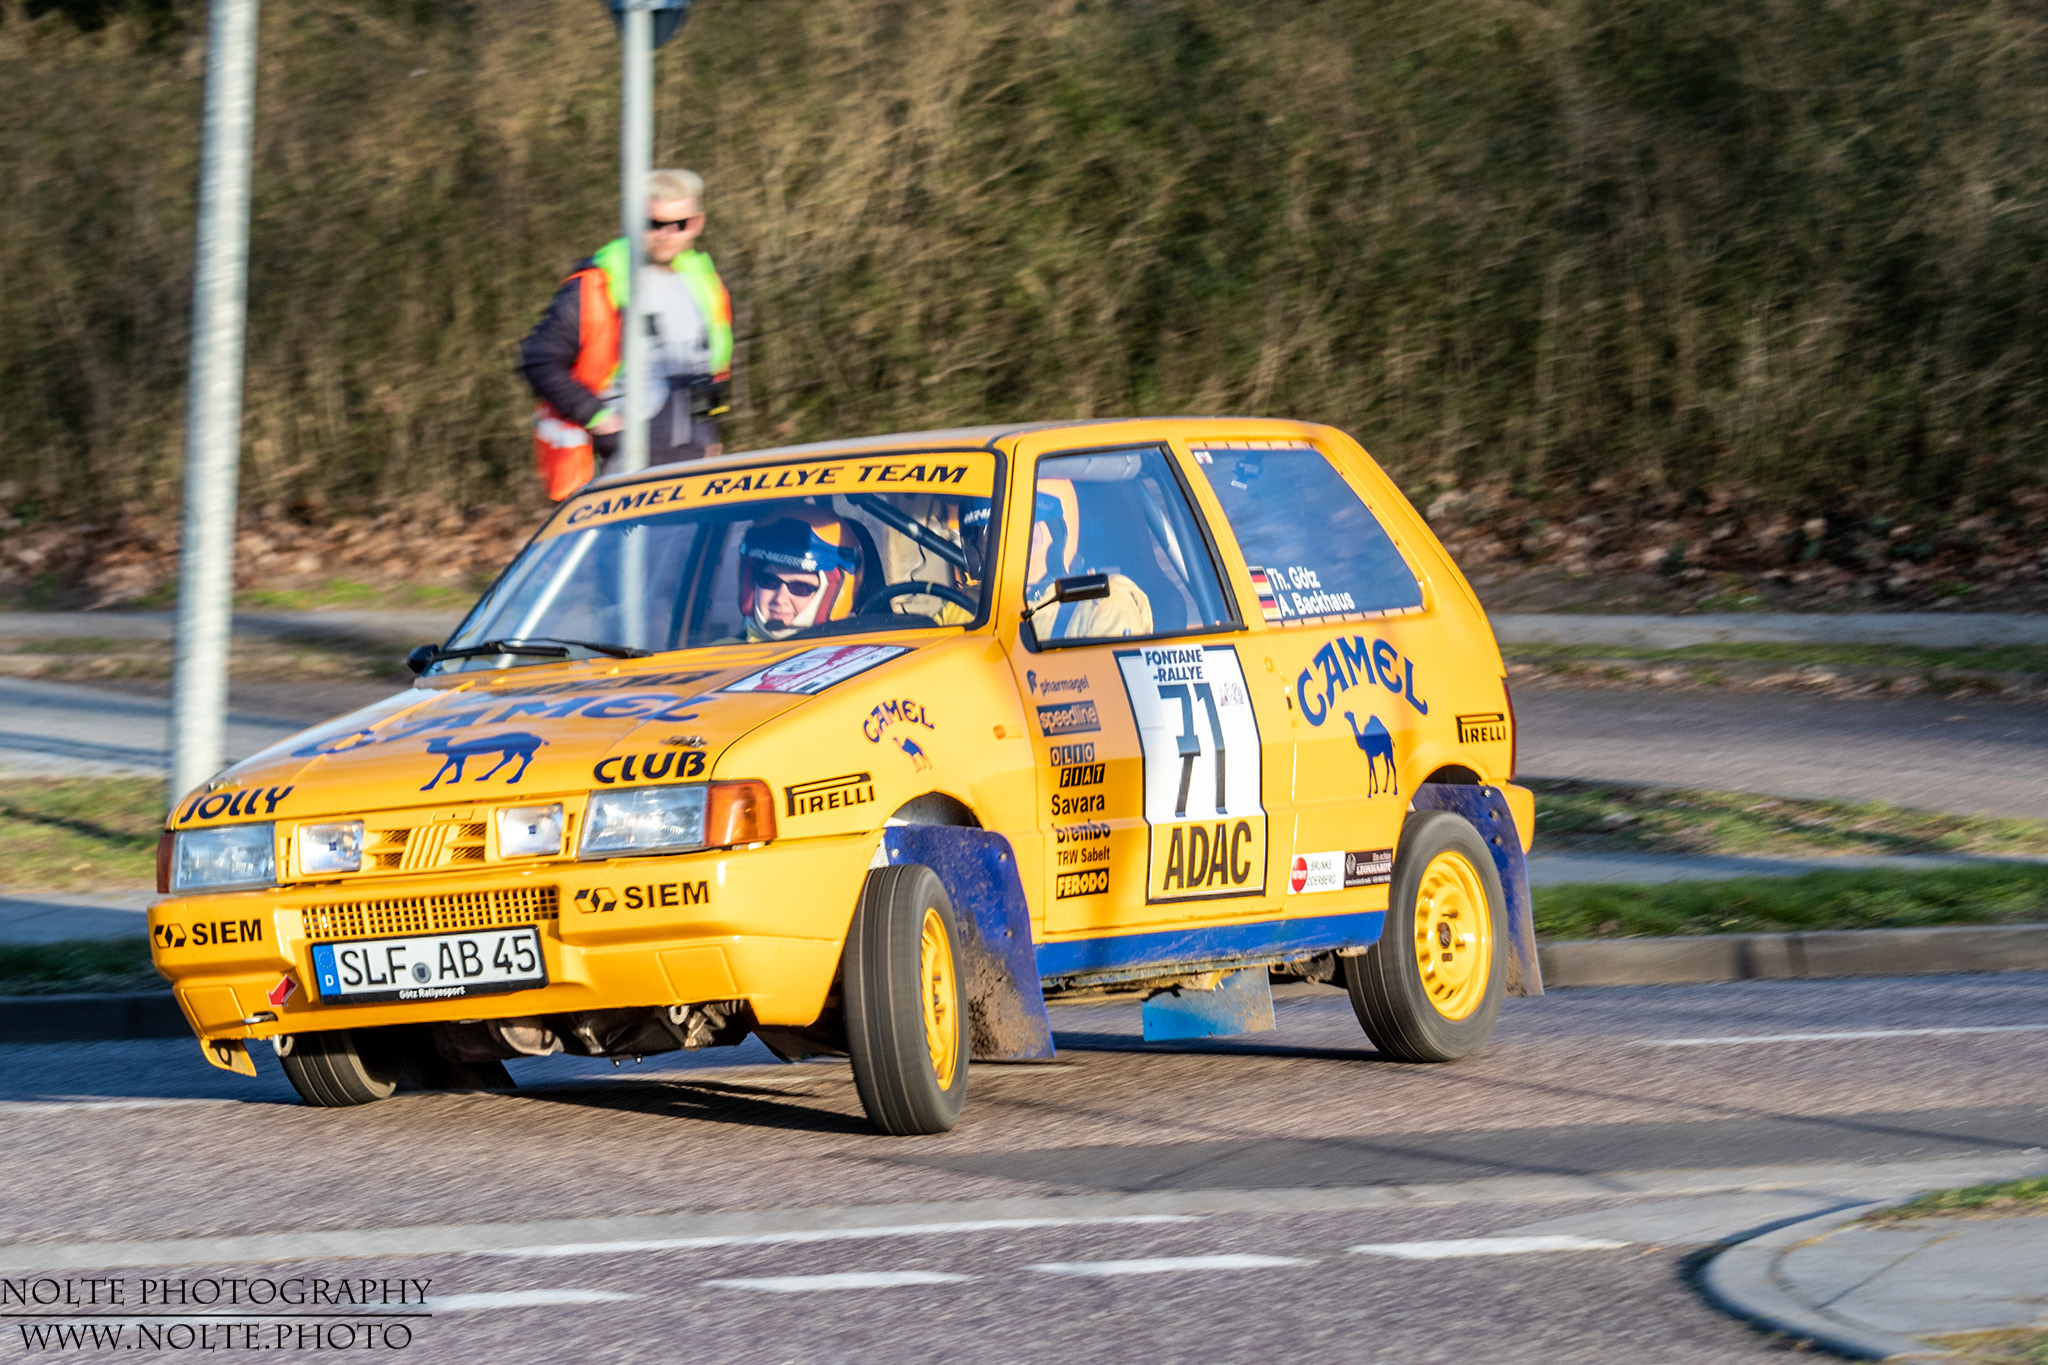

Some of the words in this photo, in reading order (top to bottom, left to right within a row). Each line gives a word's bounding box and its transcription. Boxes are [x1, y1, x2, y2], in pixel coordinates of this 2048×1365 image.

[566, 484, 688, 526] CAMEL
[700, 465, 846, 498] RALLYE
[857, 463, 970, 485] TEAM
[1267, 568, 1291, 591] Th.
[1289, 566, 1321, 590] Götz
[1278, 595, 1295, 617] A.
[1292, 591, 1355, 615] Backhaus
[1145, 649, 1203, 667] FONTANE
[1040, 674, 1090, 698] pharmagel
[1153, 666, 1204, 682] -RALLYE
[1297, 634, 1428, 727] CAMEL
[291, 693, 719, 758] CAMEL
[862, 698, 935, 744] CAMEL
[1039, 704, 1098, 734] speedline
[1456, 712, 1506, 743] PIRELLI
[1050, 742, 1095, 767] OLIO
[1157, 682, 1228, 817] 71
[593, 750, 707, 784] CLUB
[1060, 763, 1105, 788] FIAT
[179, 785, 295, 824] JOLLY
[783, 771, 876, 818] PIRELLI
[1051, 793, 1105, 816] Savara
[1052, 819, 1111, 844] brembo
[1057, 850, 1078, 867] TRW
[1081, 845, 1110, 863] Sabelt
[1163, 820, 1252, 891] ADAC
[624, 880, 711, 911] SIEM
[1057, 869, 1108, 898] FERODO
[191, 918, 263, 946] SIEM
[340, 945, 407, 986] SLF
[439, 940, 484, 980] AB
[491, 935, 536, 975] 45
[325, 974, 335, 987] D
[399, 988, 418, 1000] Götz
[419, 985, 465, 999] Rallyesport
